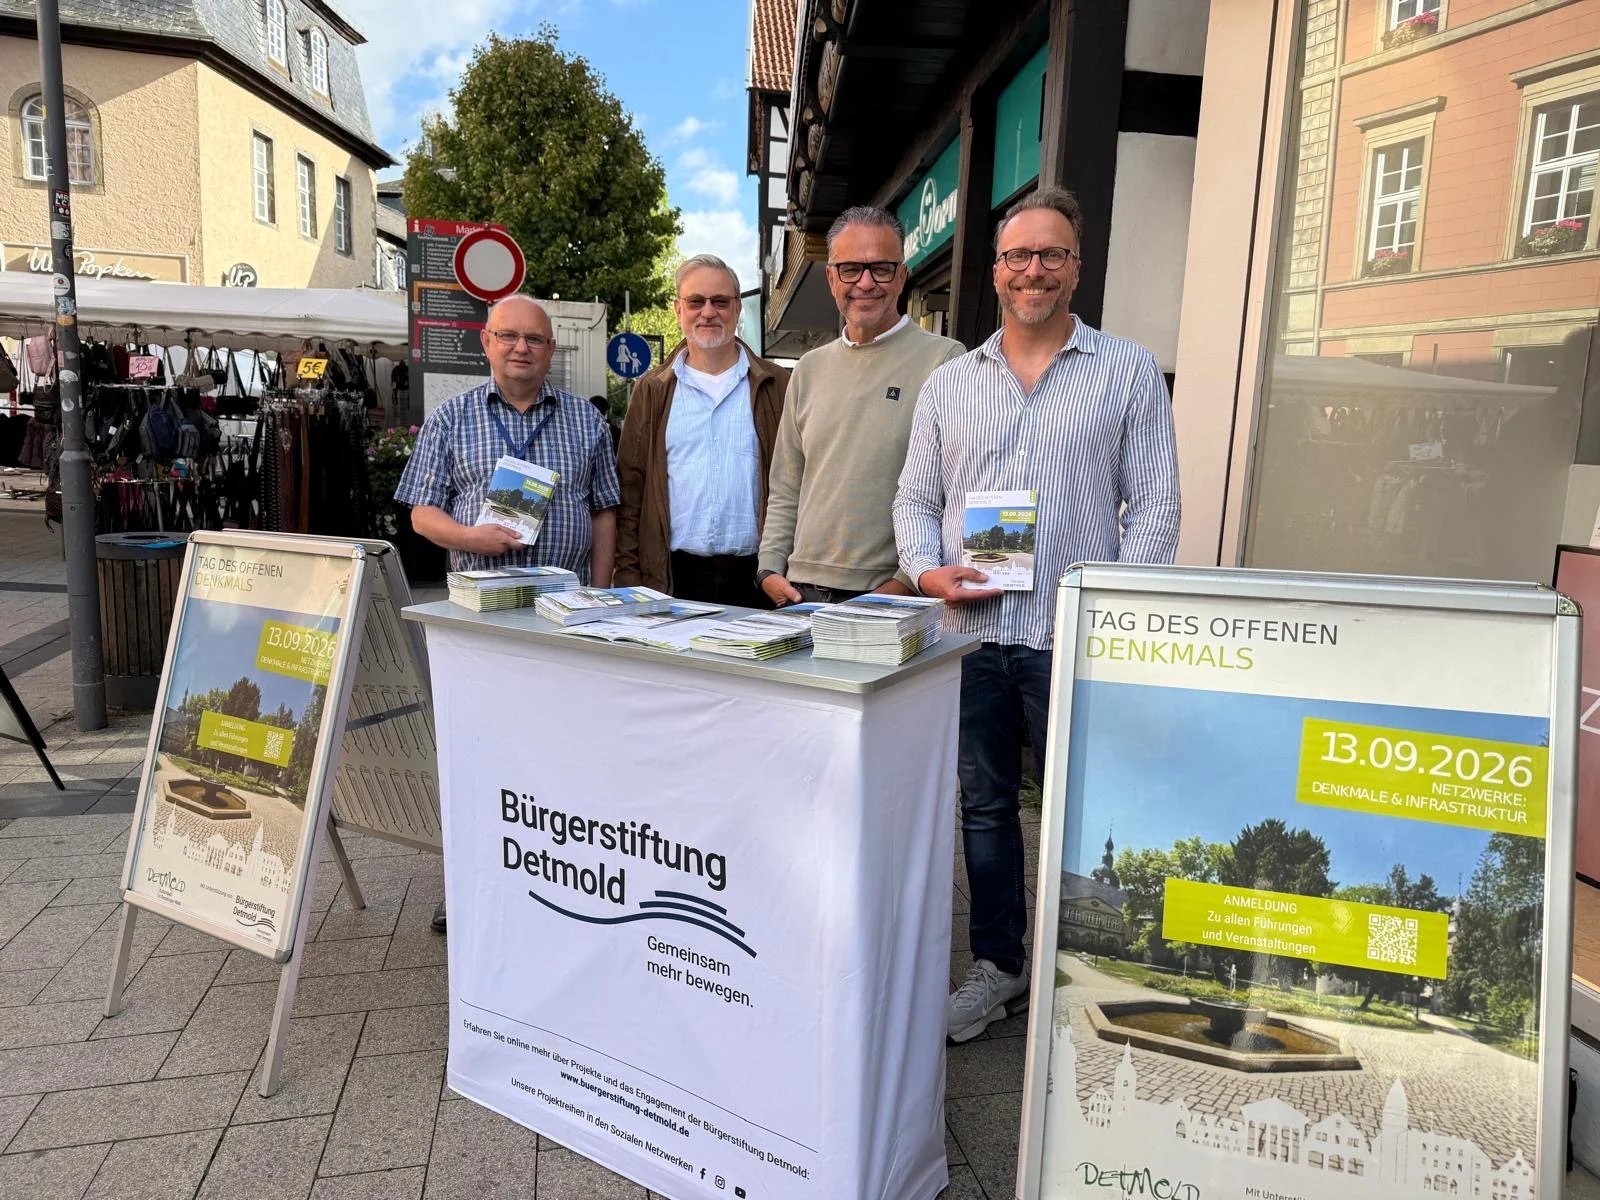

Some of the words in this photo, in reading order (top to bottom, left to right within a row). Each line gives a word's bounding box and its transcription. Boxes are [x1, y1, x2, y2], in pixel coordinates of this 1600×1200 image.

[79, 251, 160, 281] Popken
[302, 362, 320, 375] 5€
[195, 572, 254, 592] DENKMALS
[198, 556, 217, 571] TAG
[218, 558, 237, 573] DES
[240, 561, 284, 578] OFFENEN
[267, 627, 337, 660] 13.09.2026
[1086, 609, 1137, 631] TAG
[1147, 613, 1199, 636] DES
[1209, 617, 1338, 646] OFFENEN
[1086, 635, 1254, 671] DENKMALS
[1321, 731, 1533, 788] 13.09.2026
[1312, 781, 1388, 804] DENKMALE
[1391, 793, 1402, 805] &
[1405, 794, 1528, 824] INFRASTRUKTUR
[1432, 782, 1527, 807] NETZWERKE:
[501, 788, 727, 891] Bürgerstiftung
[503, 836, 625, 905] Detmold
[233, 906, 257, 922] Detmold
[235, 895, 275, 919] Bürgerstiftung
[1223, 894, 1298, 915] ANMELDUNG
[1207, 910, 1221, 923] Zu
[1224, 912, 1250, 927] allen
[1253, 916, 1313, 938] Führungen
[648, 935, 730, 976] Gemeinsam
[1202, 929, 1223, 942] und
[1225, 931, 1317, 957] Veranstaltungen
[648, 961, 683, 981] mehr
[686, 970, 754, 1007] bewegen.
[463, 1019, 492, 1038] Erfahren
[493, 1031, 506, 1042] Sie
[506, 1036, 530, 1051] online
[531, 1046, 550, 1059] mehr
[553, 1053, 569, 1066] über
[570, 1060, 602, 1080] Projekte
[603, 1074, 618, 1088] und
[619, 1081, 633, 1095] das
[636, 1088, 686, 1120] Engagement
[687, 1113, 701, 1127] der
[703, 1121, 765, 1160] Bürgerstiftung
[767, 1152, 810, 1180] Detmold:
[560, 1070, 690, 1138] www.buergerstiftung-detmold.de
[511, 1077, 536, 1095] Unsere
[537, 1089, 585, 1120] Projektreihen
[586, 1111, 594, 1124] in
[595, 1116, 609, 1131] den
[610, 1124, 644, 1148] Sozialen
[645, 1141, 693, 1173] Netzwerken
[1245, 1187, 1260, 1198] Mit
